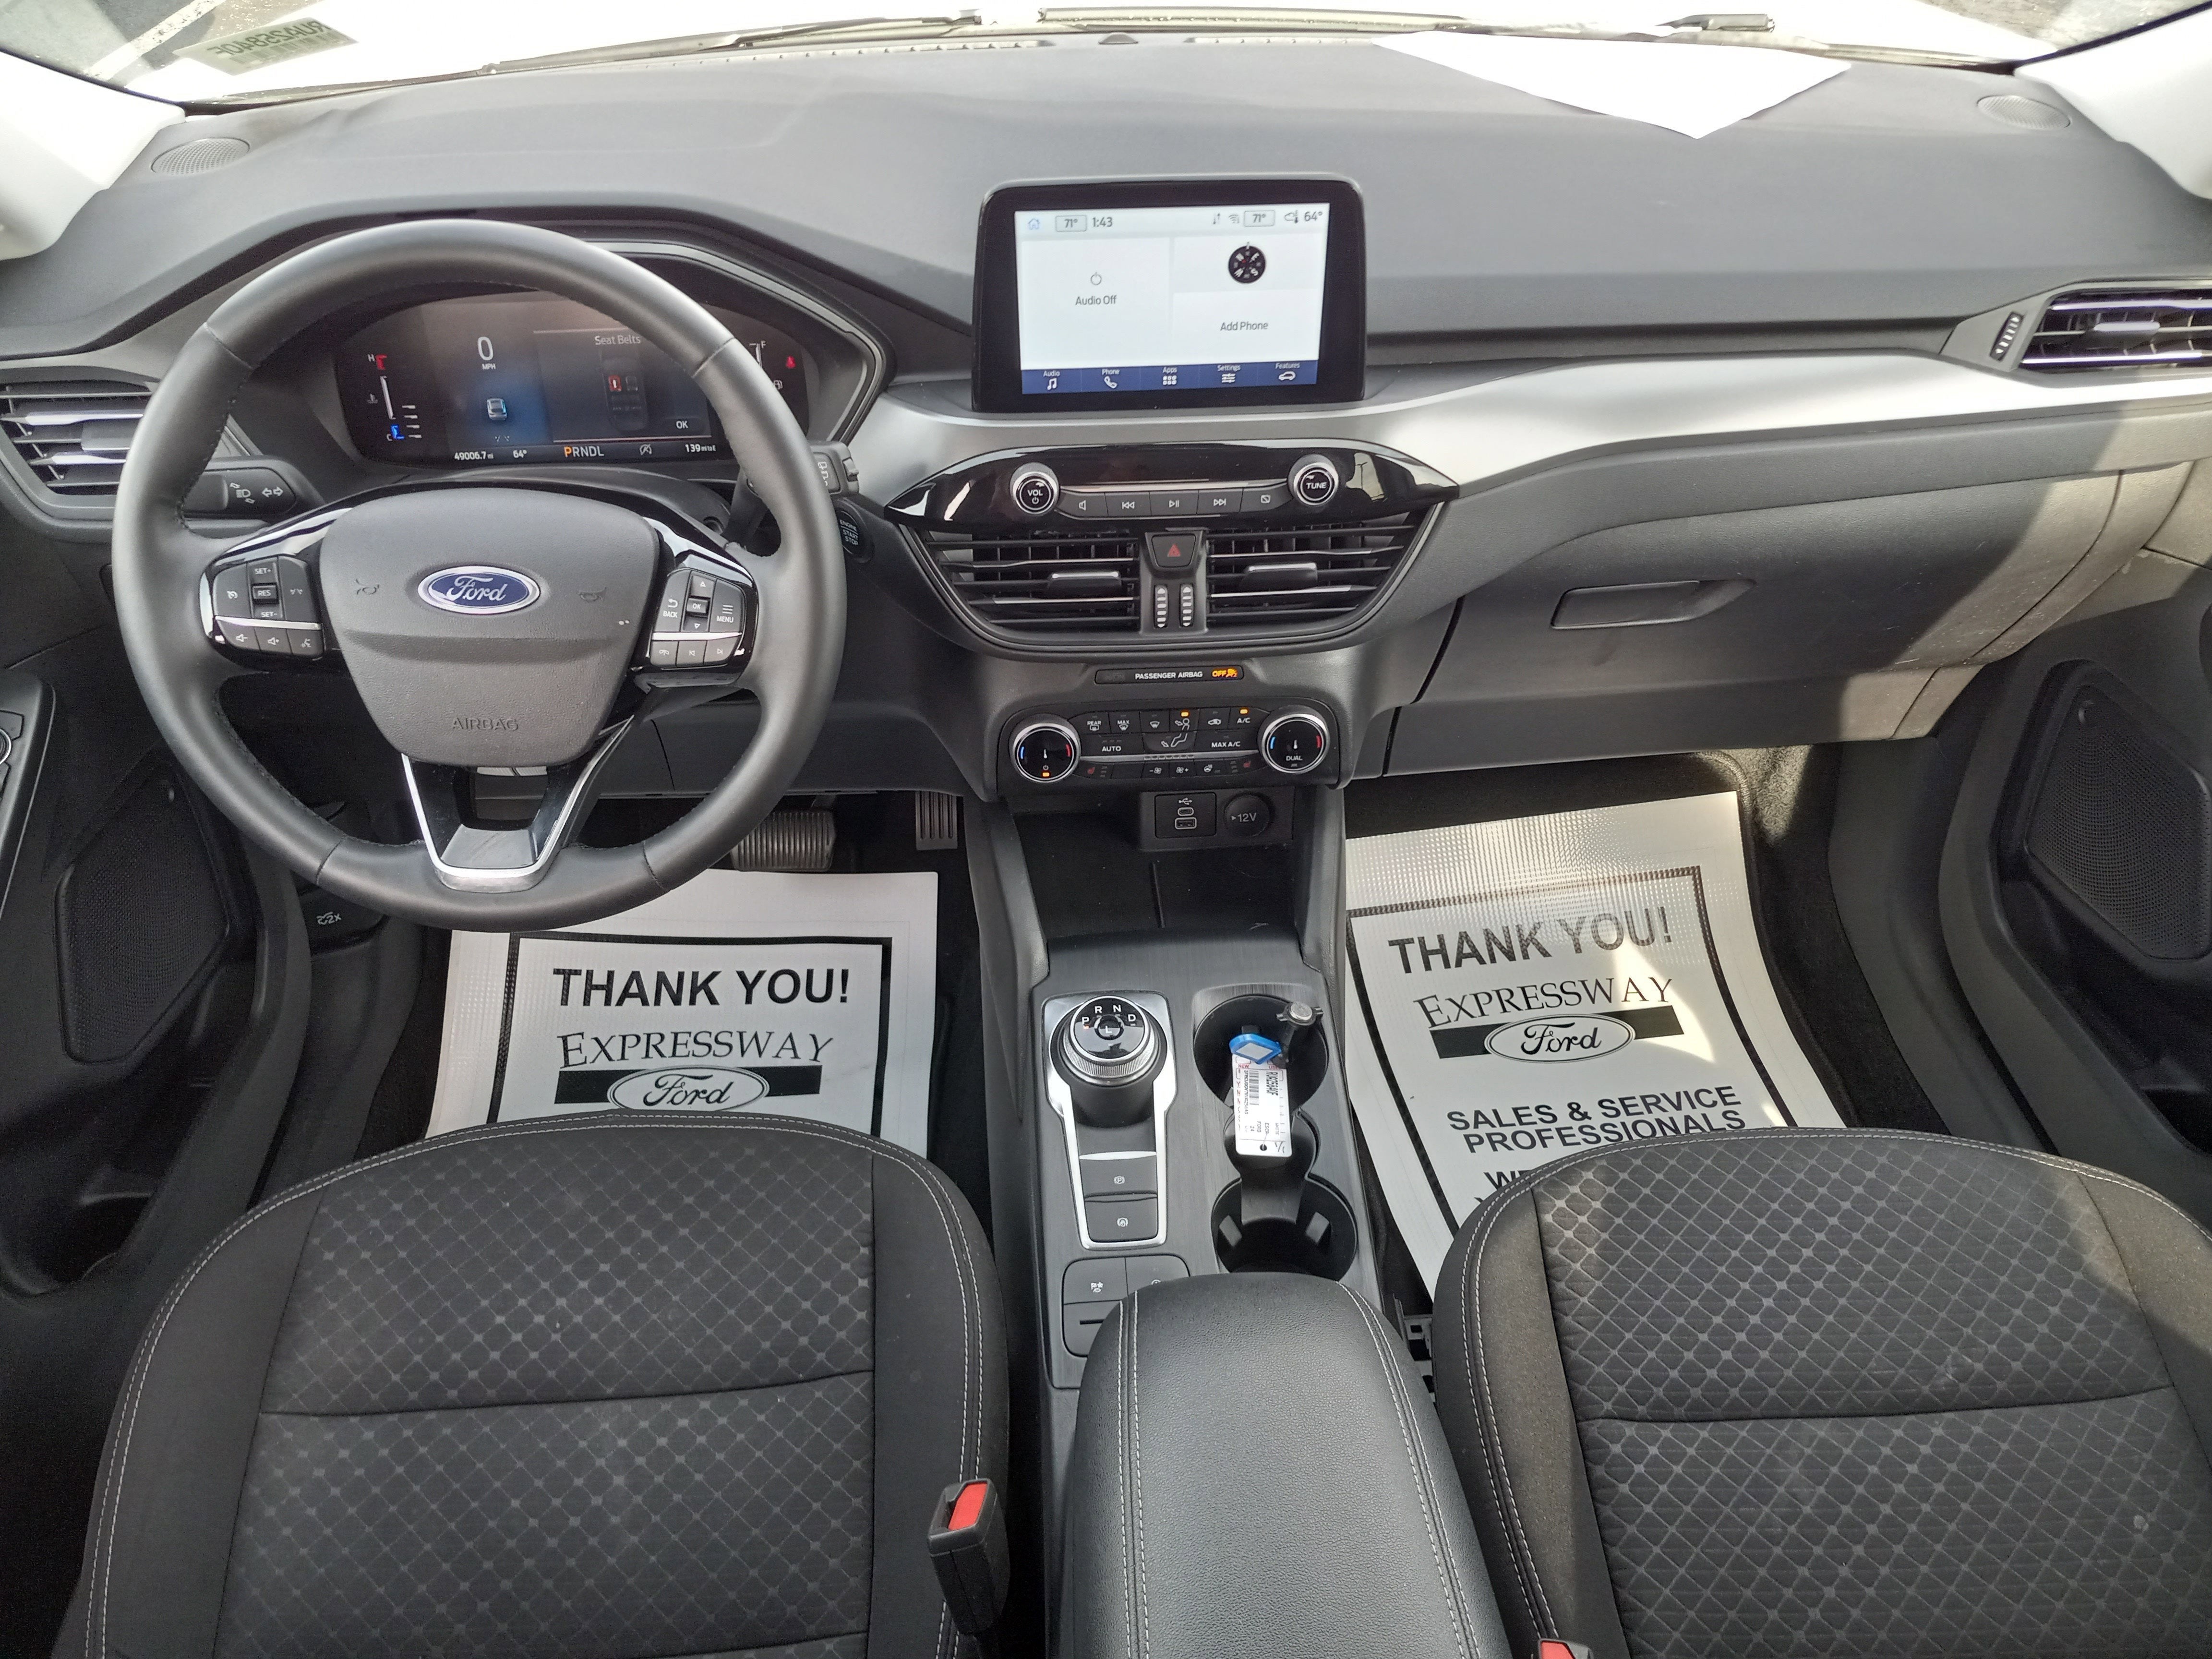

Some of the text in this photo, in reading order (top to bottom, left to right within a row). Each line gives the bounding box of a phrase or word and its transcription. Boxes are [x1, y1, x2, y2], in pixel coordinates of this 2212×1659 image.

[1304, 211, 1322, 221] 64°
[1092, 217, 1113, 228] 1:43
[1075, 295, 1117, 305] Audio Off
[1220, 321, 1268, 331] Add Phone
[595, 335, 641, 345] Seat Belts
[477, 337, 493, 361] 0
[676, 421, 688, 429] OK
[564, 445, 604, 457] PRNDL
[685, 444, 700, 452] 139
[454, 451, 486, 460] 49006.7
[840, 519, 857, 532] ENGINE
[842, 529, 858, 540] START
[845, 536, 858, 545] STOP
[446, 576, 508, 601] Ford
[453, 717, 518, 731] AIRBAG
[1238, 813, 1257, 822] 12V
[1388, 906, 1672, 974] THANK YOU!
[553, 968, 850, 1007] THANK YOU!
[1413, 977, 1672, 1029] EXPRESSWAY
[1082, 1017, 1090, 1025] P
[1521, 1022, 1601, 1055] Ford
[557, 1030, 834, 1069] EXPRESSWAY
[643, 1073, 734, 1106] Ford
[1447, 1086, 1742, 1130] SALES & SERVICE
[1463, 1110, 1746, 1153] PROFESSIONALS
